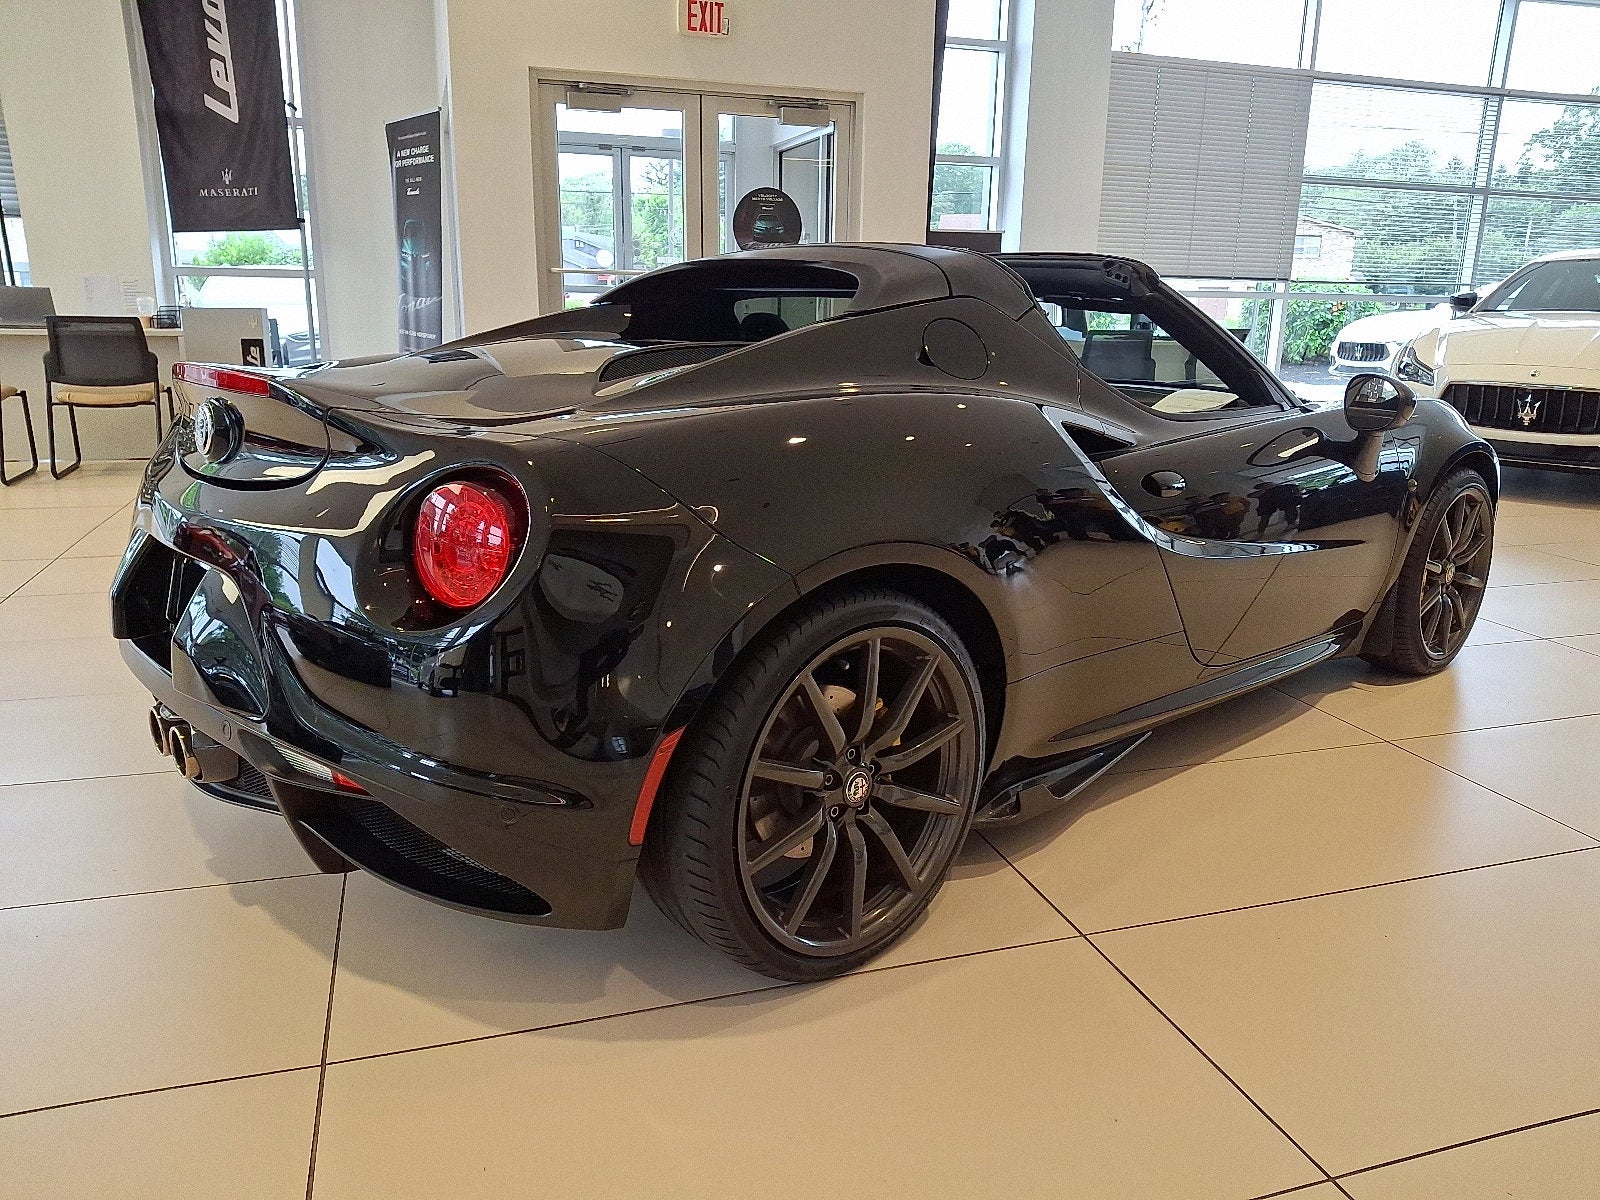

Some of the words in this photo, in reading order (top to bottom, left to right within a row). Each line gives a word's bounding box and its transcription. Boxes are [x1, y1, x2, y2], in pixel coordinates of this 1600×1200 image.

[687, 0, 725, 34] EXIT
[410, 144, 430, 156] CHARGE
[402, 154, 435, 167] PERFORMANCE
[199, 186, 259, 197] MASERATI
